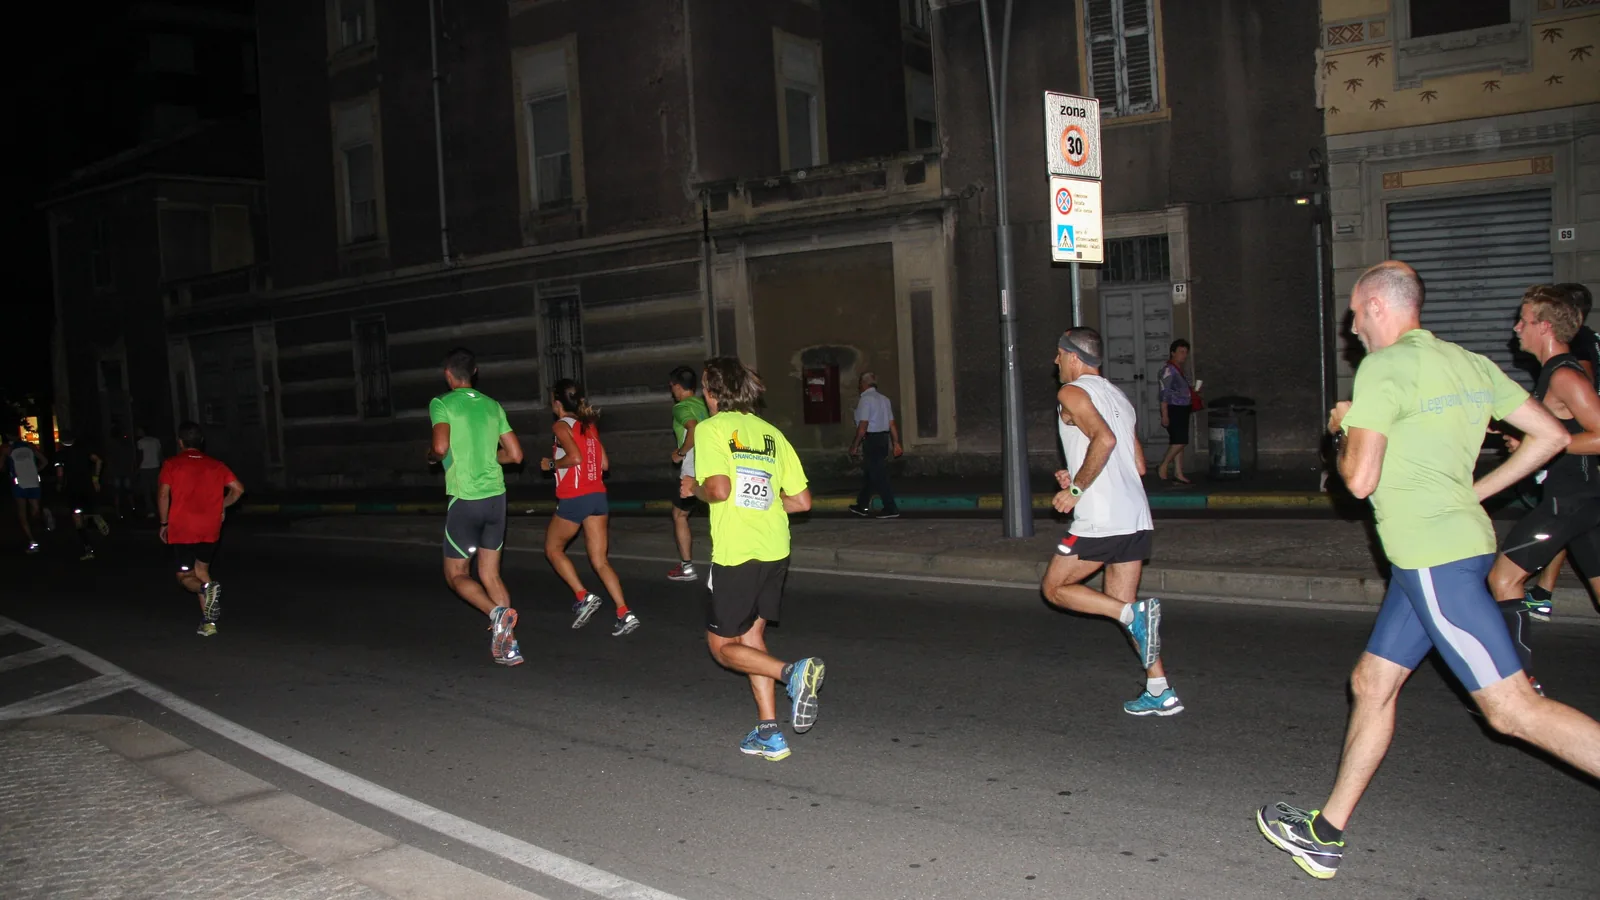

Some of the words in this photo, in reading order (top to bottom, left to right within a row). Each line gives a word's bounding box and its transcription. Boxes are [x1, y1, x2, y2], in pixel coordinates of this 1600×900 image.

[1060, 105, 1086, 118] zona
[1068, 136, 1082, 155] 30
[1561, 230, 1572, 239] 69
[1175, 285, 1184, 293] 67
[743, 483, 768, 497] 205
